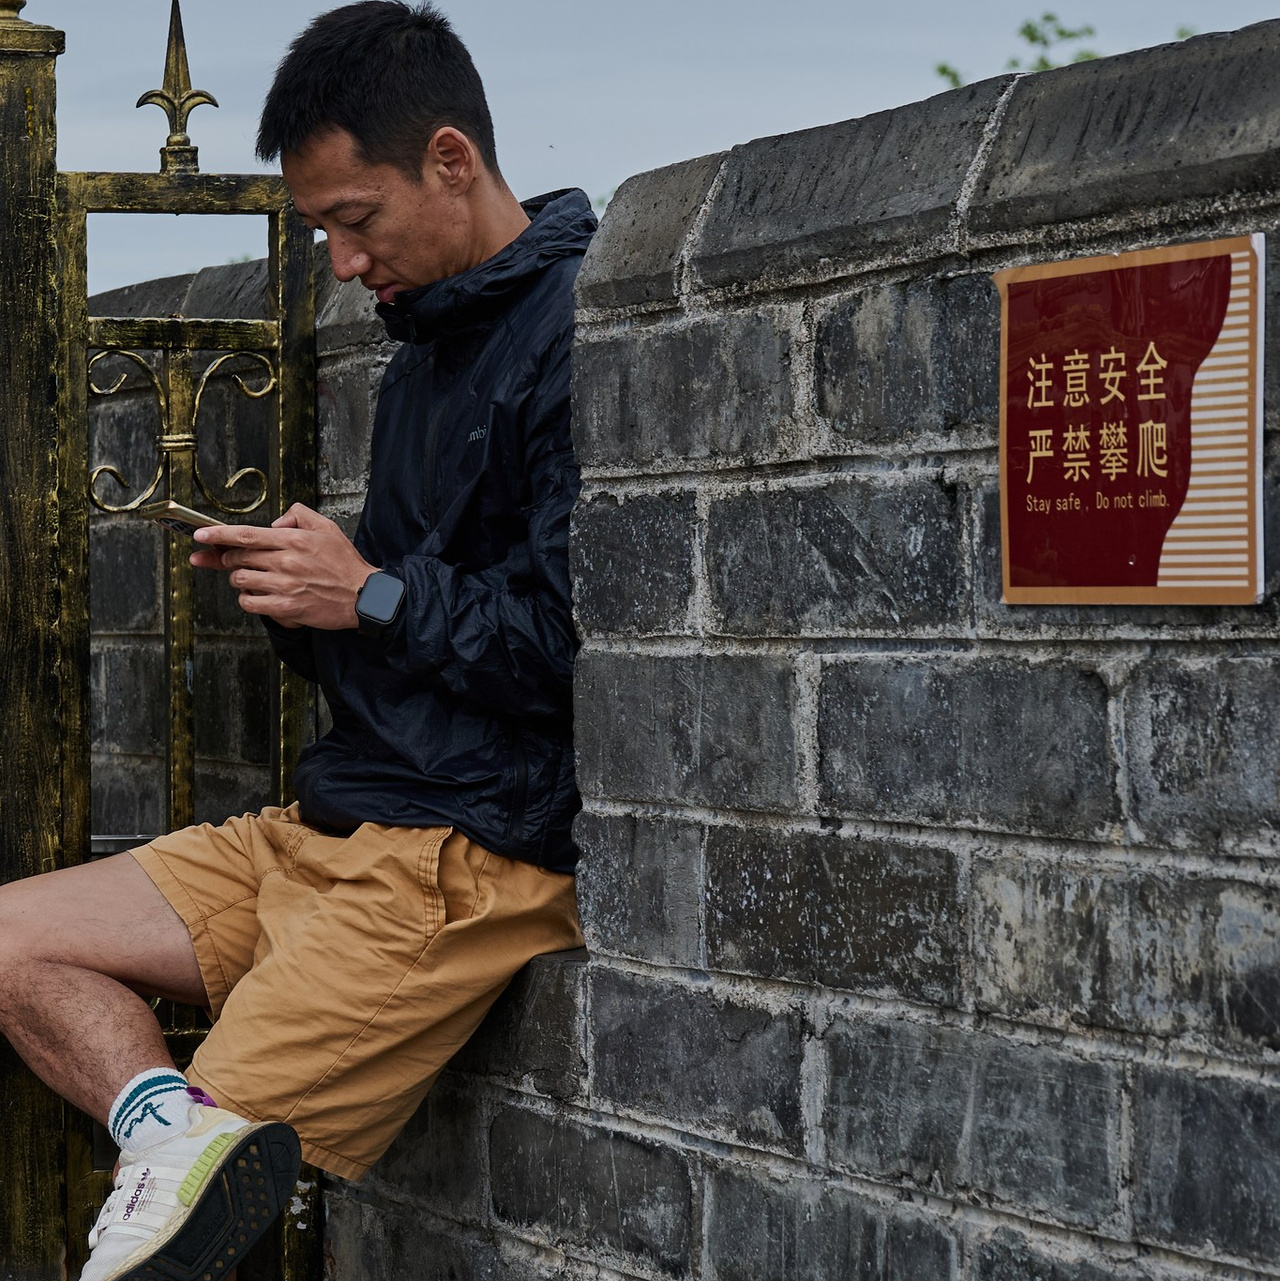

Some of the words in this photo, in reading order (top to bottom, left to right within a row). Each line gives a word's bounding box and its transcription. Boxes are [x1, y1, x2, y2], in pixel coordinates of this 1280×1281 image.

[1027, 341, 1168, 409] 注意安全
[1026, 419, 1168, 484] 严禁攀爬
[1026, 494, 1051, 515] Stay
[1096, 491, 1110, 510] Do
[1114, 492, 1134, 509] not
[123, 1182, 146, 1221] adidas
